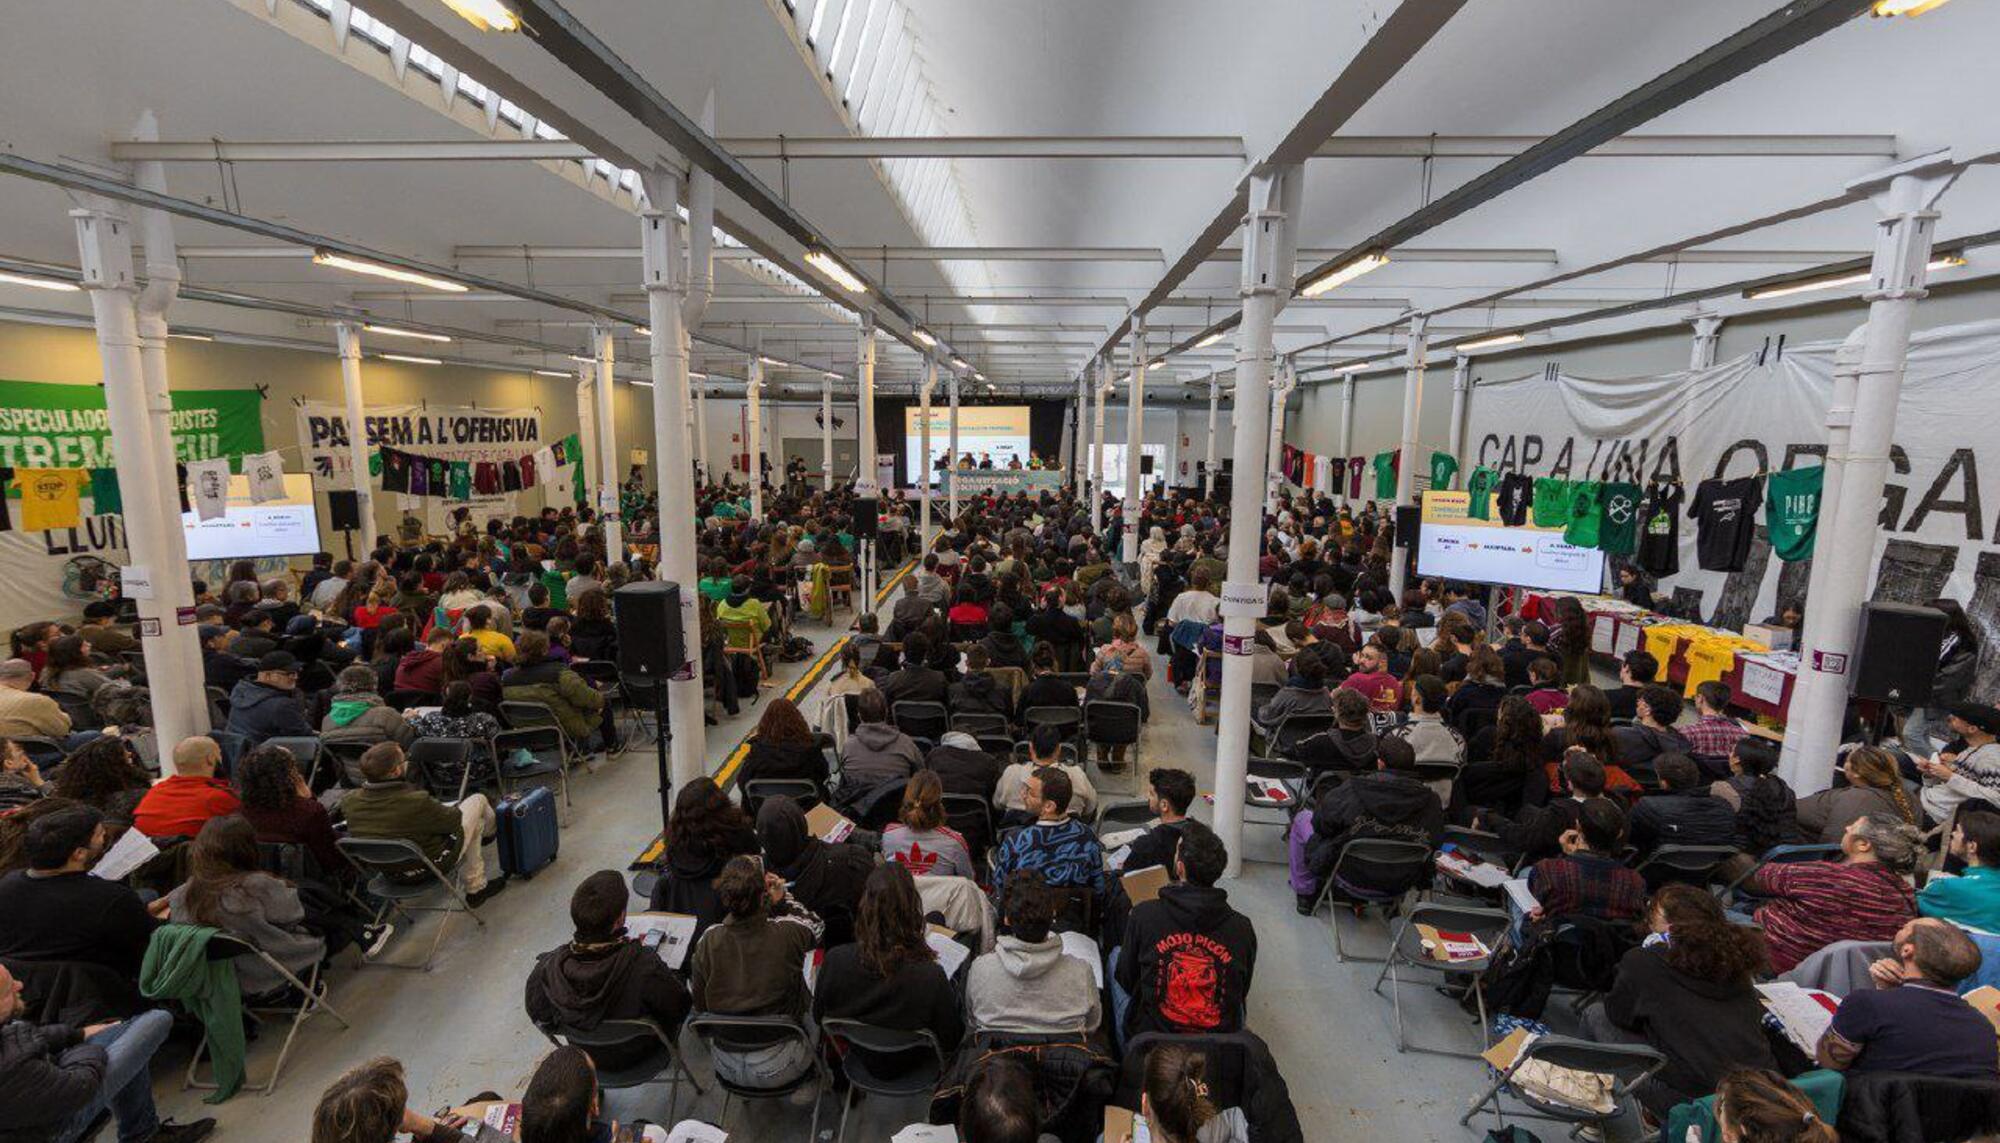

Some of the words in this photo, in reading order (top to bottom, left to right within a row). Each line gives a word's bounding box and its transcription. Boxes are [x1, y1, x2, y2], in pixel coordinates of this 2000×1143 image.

[309, 416, 413, 448] PASEM
[417, 416, 434, 445] A
[437, 416, 538, 444] L'OFENSIVA
[1479, 434, 1544, 476] CAP
[1550, 436, 1575, 480] A
[1156, 932, 1194, 955] MOJO
[1194, 934, 1233, 964] PICON
